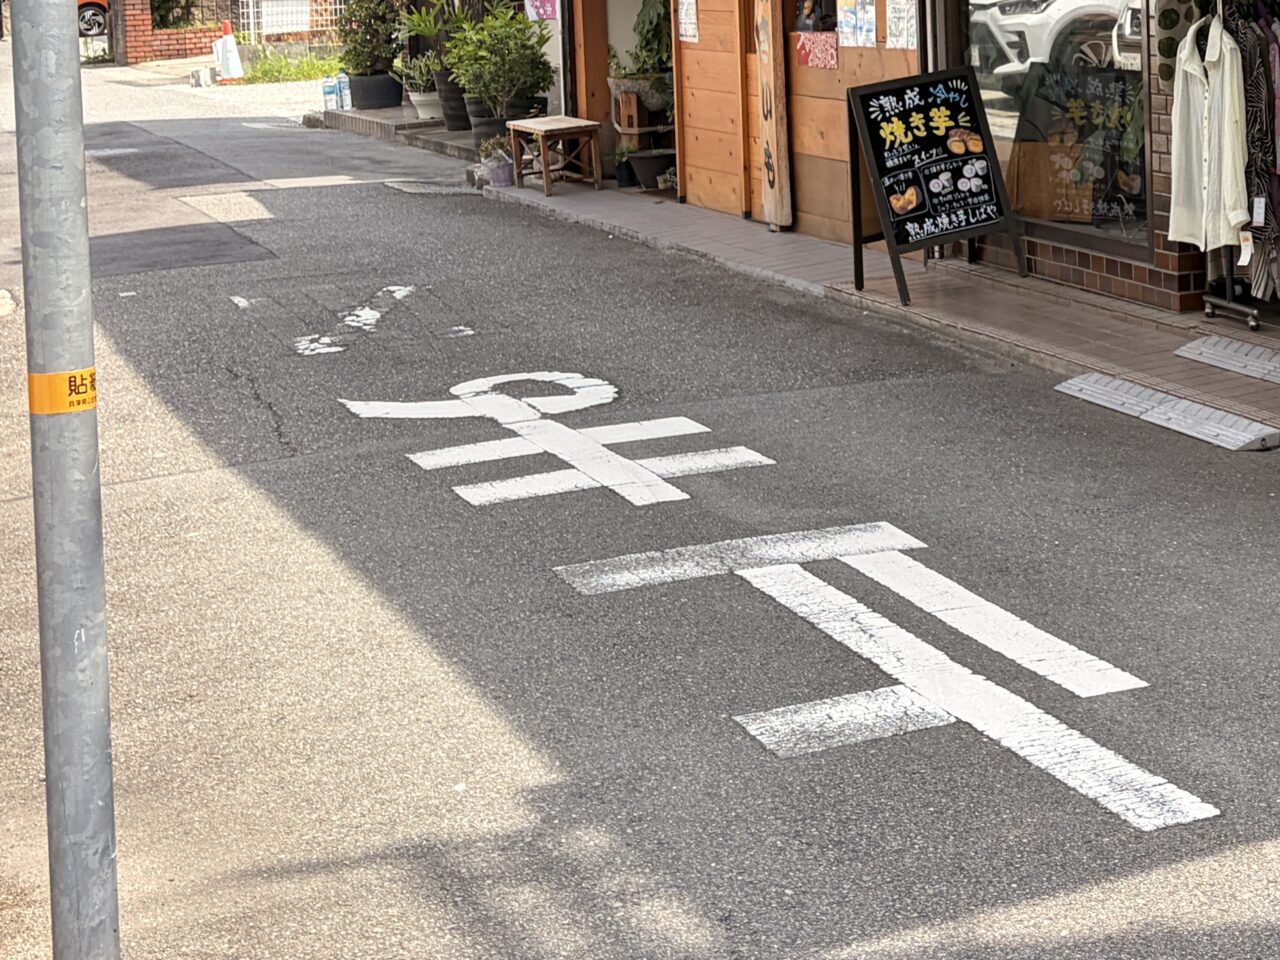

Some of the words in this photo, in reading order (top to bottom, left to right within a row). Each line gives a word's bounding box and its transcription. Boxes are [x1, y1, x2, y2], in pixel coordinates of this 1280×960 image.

[879, 87, 925, 117] 熟成
[879, 106, 955, 150] 焼き芋
[905, 205, 996, 243] 熟成焼き芋しばや
